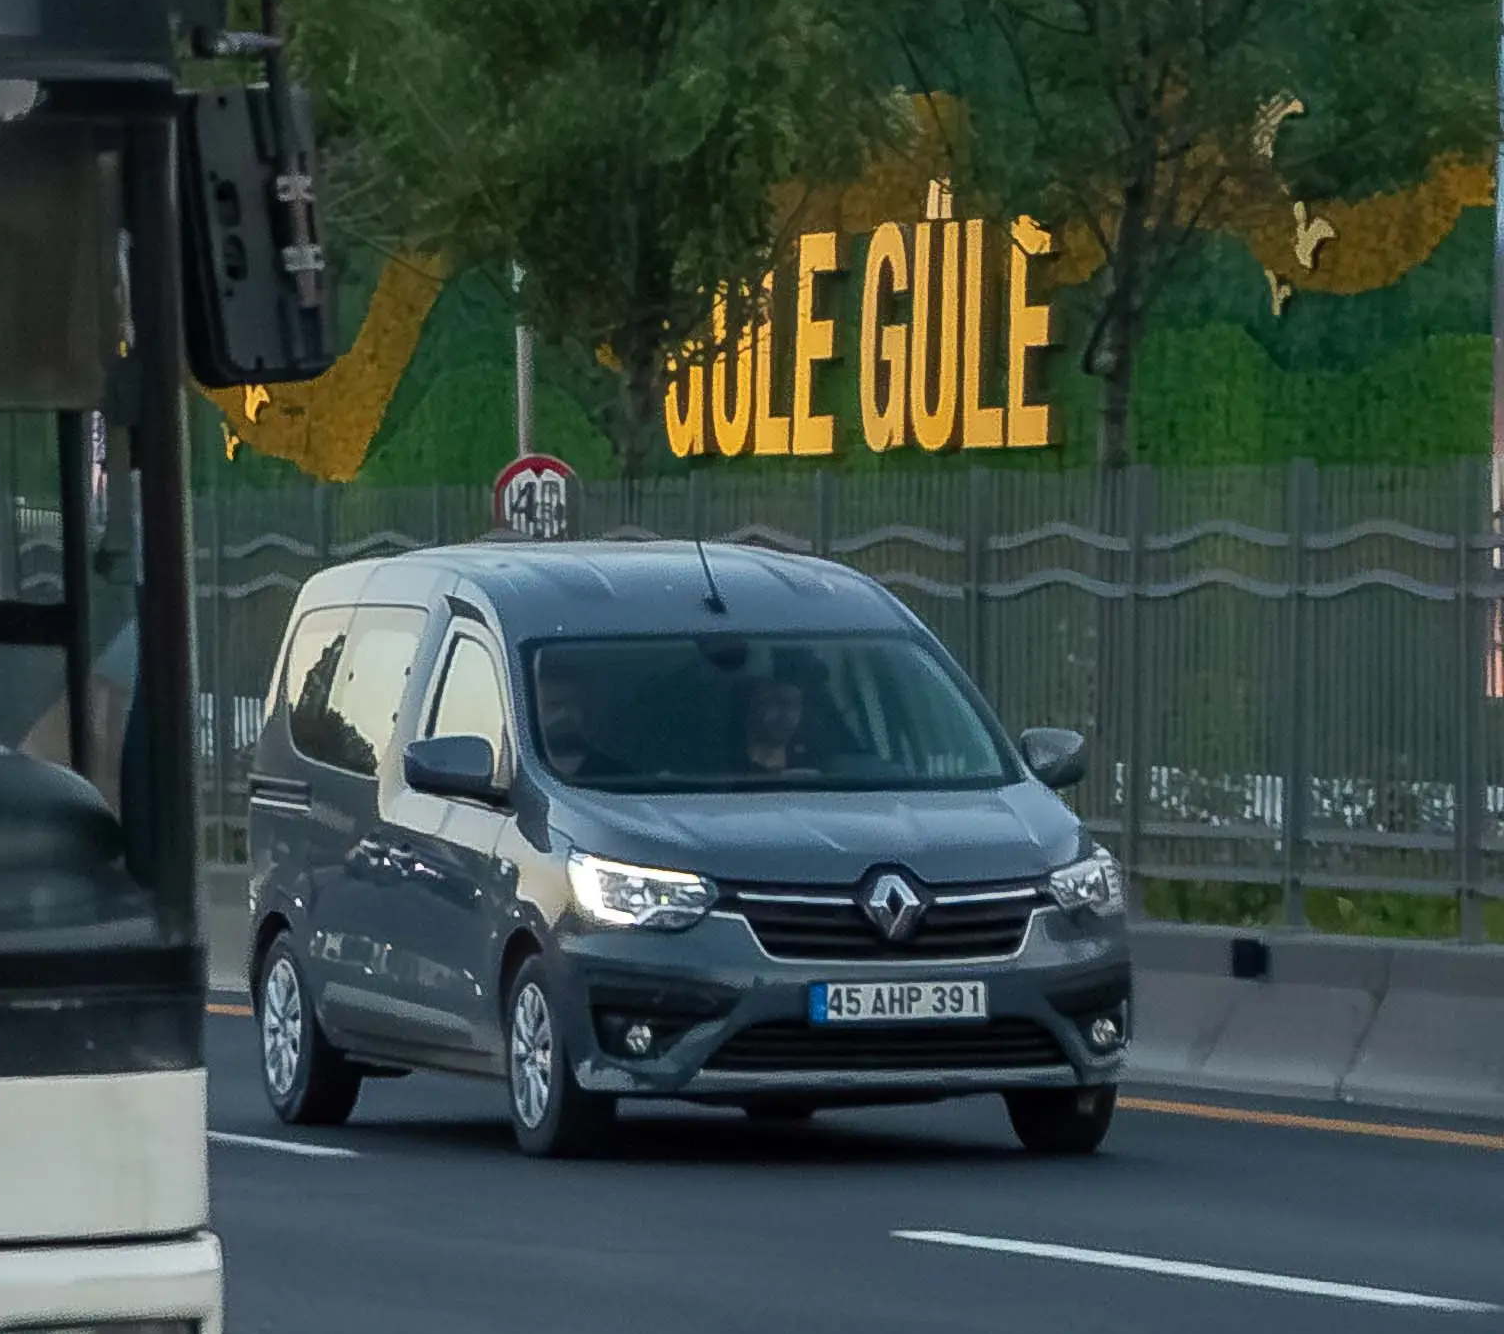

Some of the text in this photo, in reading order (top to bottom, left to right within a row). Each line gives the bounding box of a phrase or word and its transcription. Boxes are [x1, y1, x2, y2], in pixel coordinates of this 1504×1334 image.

[860, 177, 1054, 454] GÜLE
[829, 985, 980, 1017] 45 AHP 391
